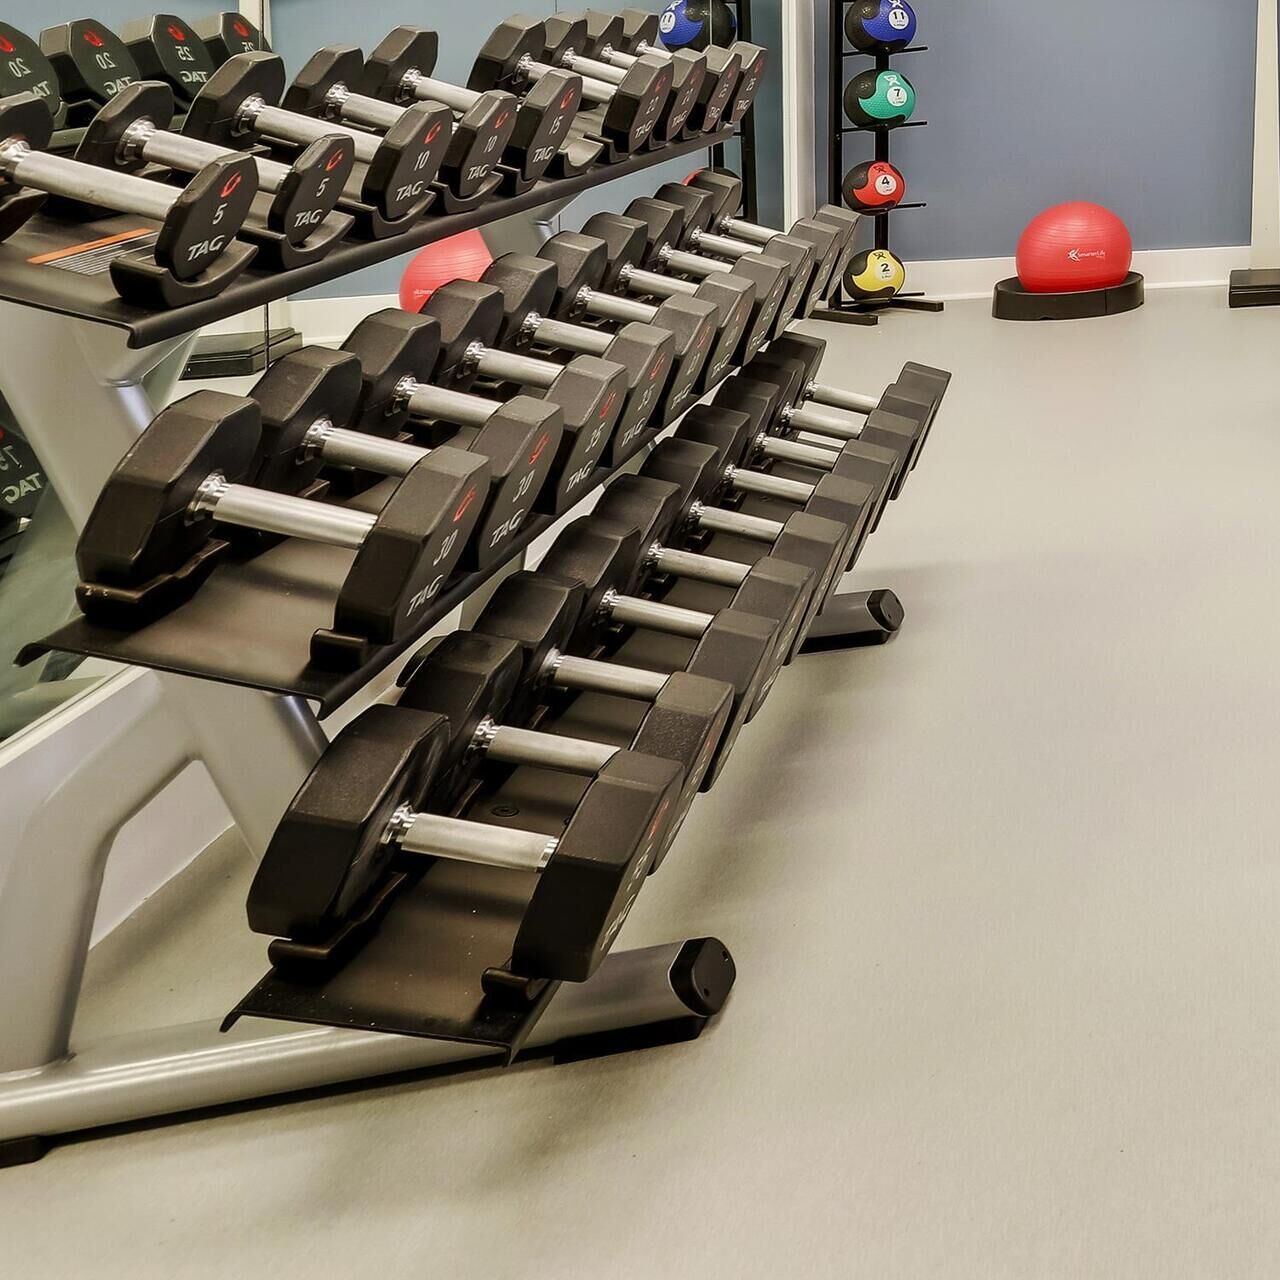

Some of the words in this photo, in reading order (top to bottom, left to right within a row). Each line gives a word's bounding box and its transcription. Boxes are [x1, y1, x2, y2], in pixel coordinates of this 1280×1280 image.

[893, 11, 905, 20] 11
[549, 115, 564, 135] 15
[635, 120, 653, 139] TAG
[483, 135, 498, 153] 10
[532, 145, 555, 163] TAG
[414, 150, 431, 171] 10
[467, 164, 490, 181] TAG
[316, 177, 330, 198] 5
[395, 180, 425, 202] TAG
[212, 203, 228, 225] 5
[293, 208, 323, 228] TAG
[187, 234, 226, 262] TAG
[585, 422, 604, 453] 35
[622, 417, 646, 448] TAG
[512, 469, 535, 503] 30
[566, 459, 594, 493] TAG
[490, 508, 525, 549] TAG
[433, 528, 458, 567] 30
[406, 574, 444, 617] TAG
